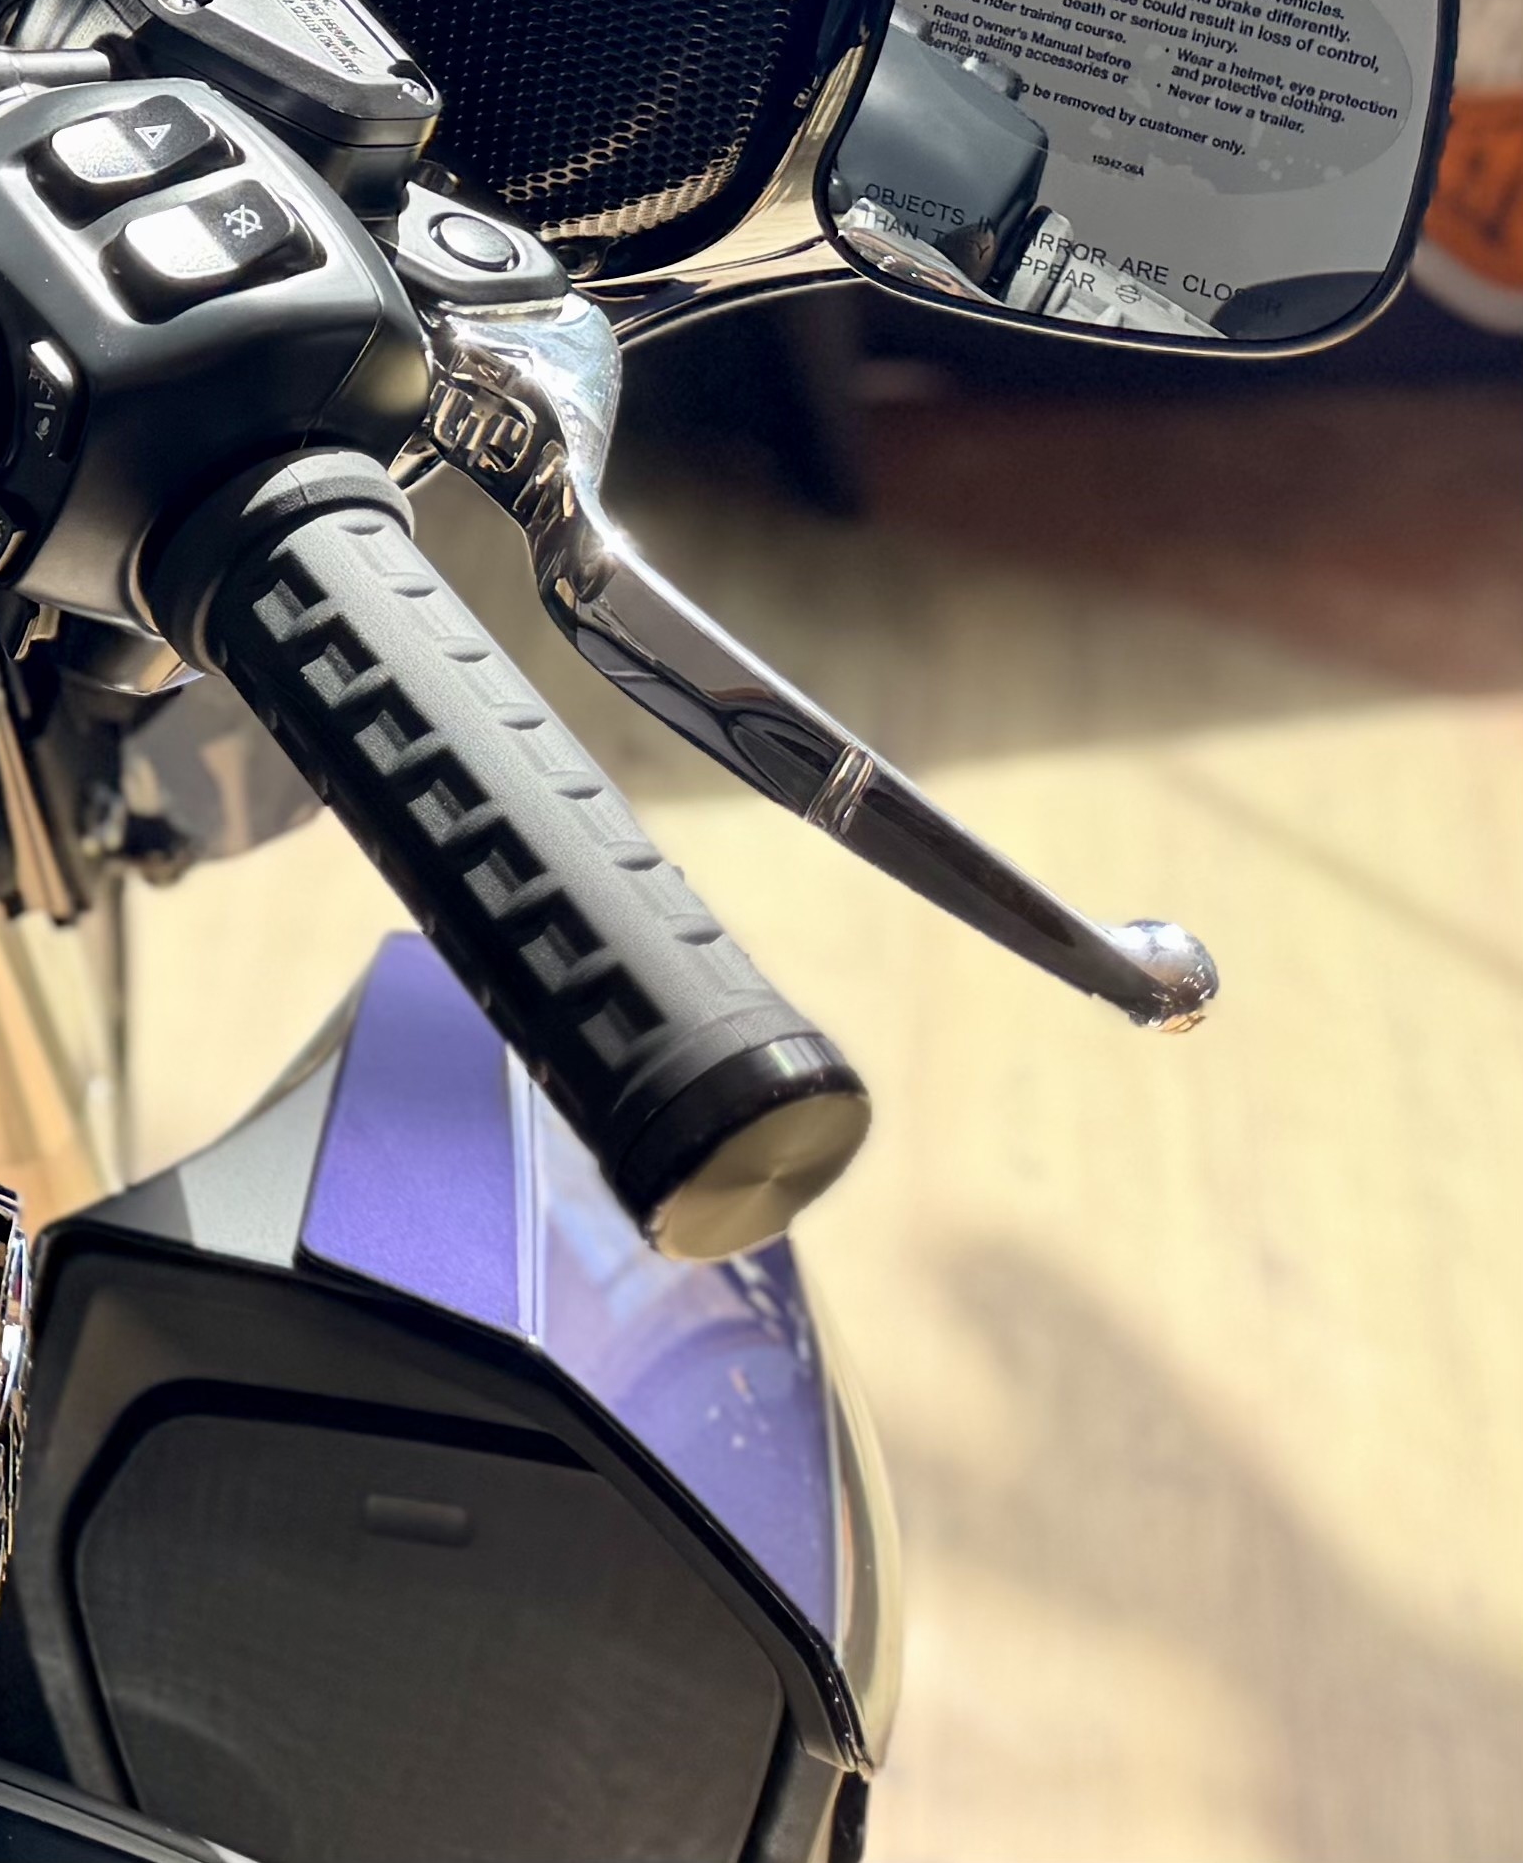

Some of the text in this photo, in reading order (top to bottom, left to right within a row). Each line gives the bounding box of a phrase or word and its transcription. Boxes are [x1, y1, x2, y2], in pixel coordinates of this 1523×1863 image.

[929, 20, 1129, 85] riding, adding accessories or
[932, 4, 1132, 70] Read Owner's Manual before
[1020, 4, 1071, 30] training
[1075, 20, 1127, 44] course.
[1110, 9, 1127, 23] or
[1130, 12, 1188, 39] serious
[1191, 27, 1238, 53] injury.
[1189, 10, 1236, 35] result
[1239, 21, 1254, 37] in
[1258, 25, 1291, 47] loss
[1296, 36, 1314, 52] of
[1316, 42, 1380, 73] control,
[1267, 8, 1351, 43] differently.
[1166, 83, 1305, 134] Never tow a trailer.
[1171, 64, 1346, 123] and protective clothing.
[1177, 47, 1398, 119] Wear a helmet, eye protection
[1033, 82, 1051, 100] be
[1053, 92, 1116, 119] removed
[1119, 109, 1137, 126] by
[1139, 114, 1208, 144] customer
[1212, 135, 1246, 156] only.
[863, 183, 965, 226] OBJECTS
[1025, 231, 1107, 267] IRROR
[1119, 255, 1170, 285] ARE
[1015, 253, 1095, 293] PPEAR
